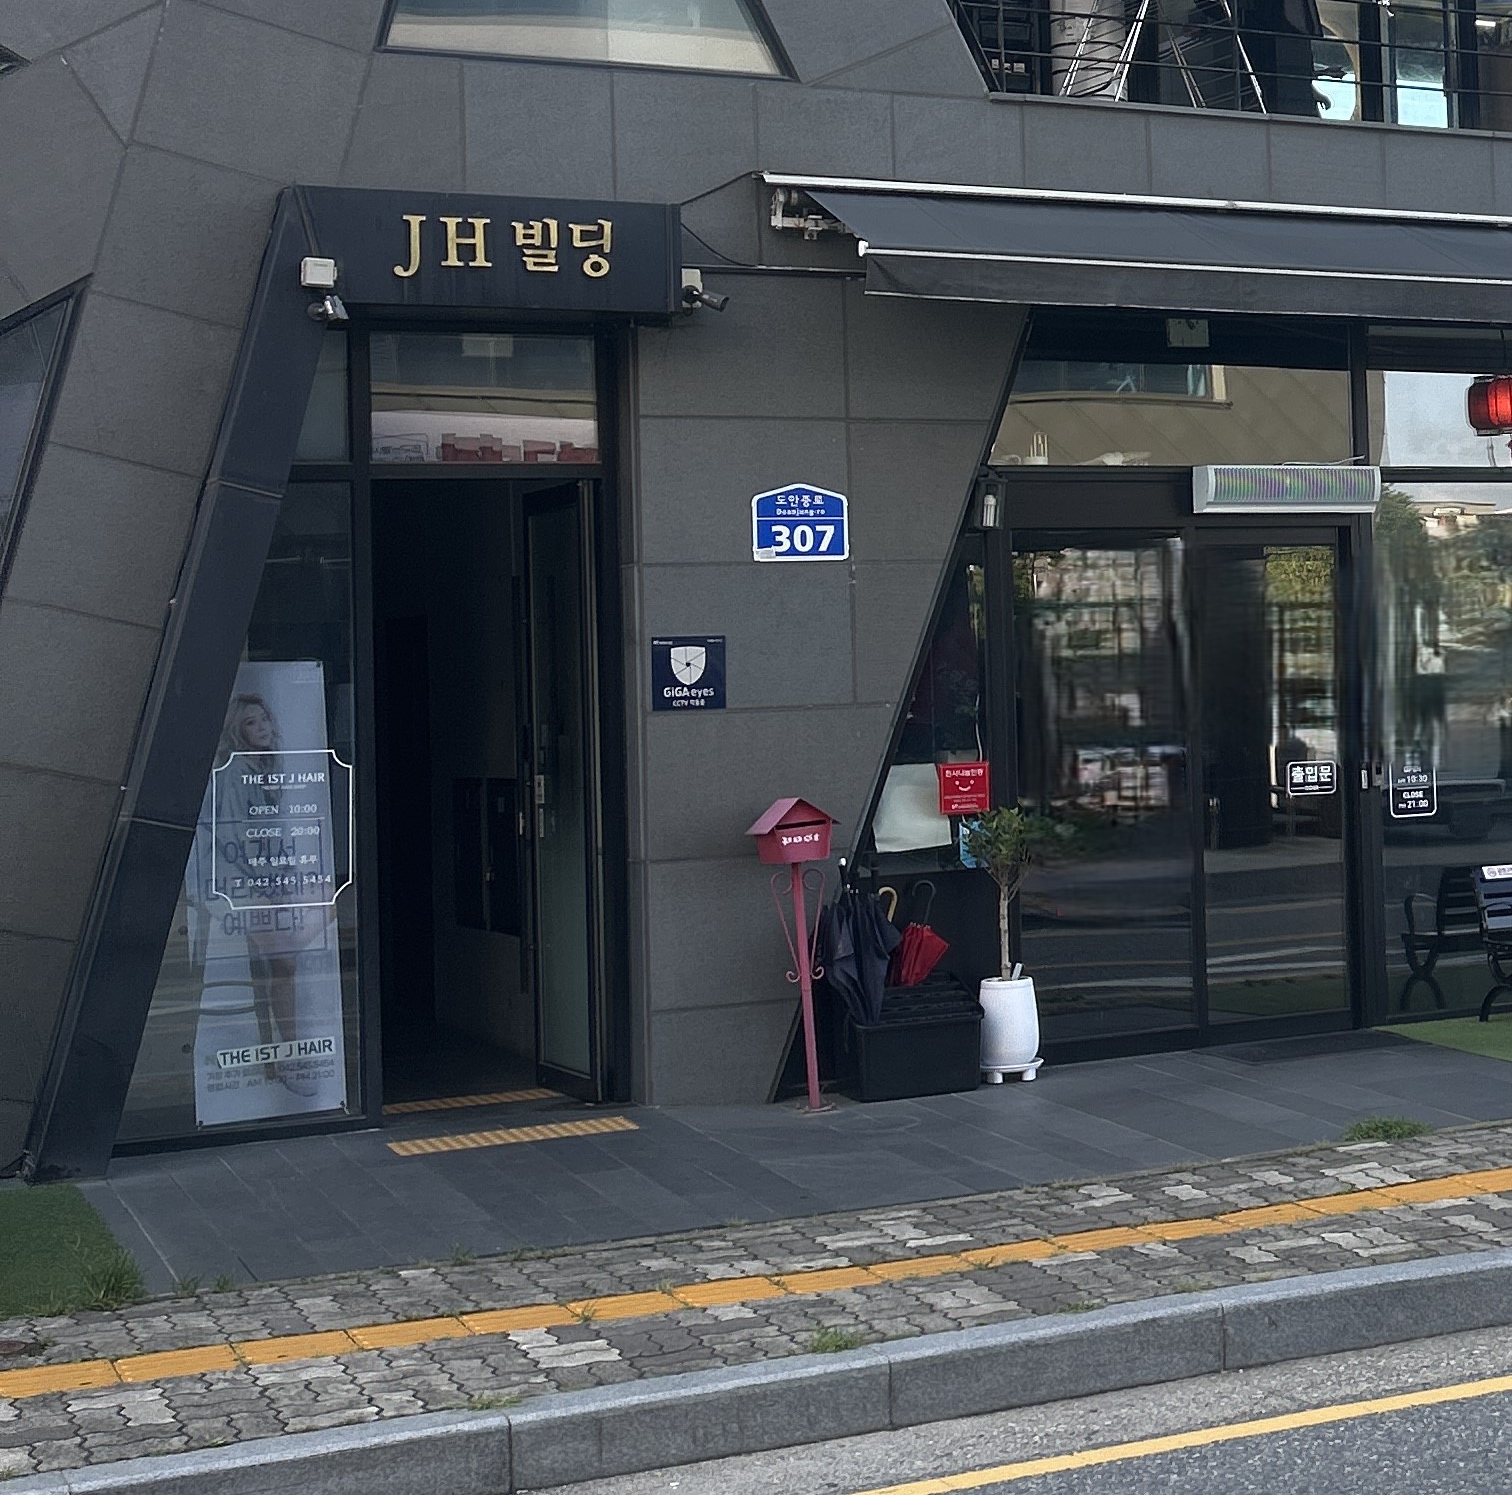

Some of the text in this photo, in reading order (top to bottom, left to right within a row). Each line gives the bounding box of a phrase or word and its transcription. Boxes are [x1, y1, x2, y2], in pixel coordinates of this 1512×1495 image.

[511, 218, 614, 278] 빌딩
[771, 524, 835, 553] 307
[691, 687, 715, 698] eyes
[241, 773, 264, 785] THE
[288, 772, 295, 784] J
[297, 772, 325, 783] HAIR
[1291, 765, 1333, 783] 출입문
[248, 804, 318, 816] OPEN 10:00
[245, 827, 282, 839] CLOSE
[219, 1048, 251, 1066] THE
[284, 1044, 293, 1058] J
[297, 1038, 333, 1057] HAIR
